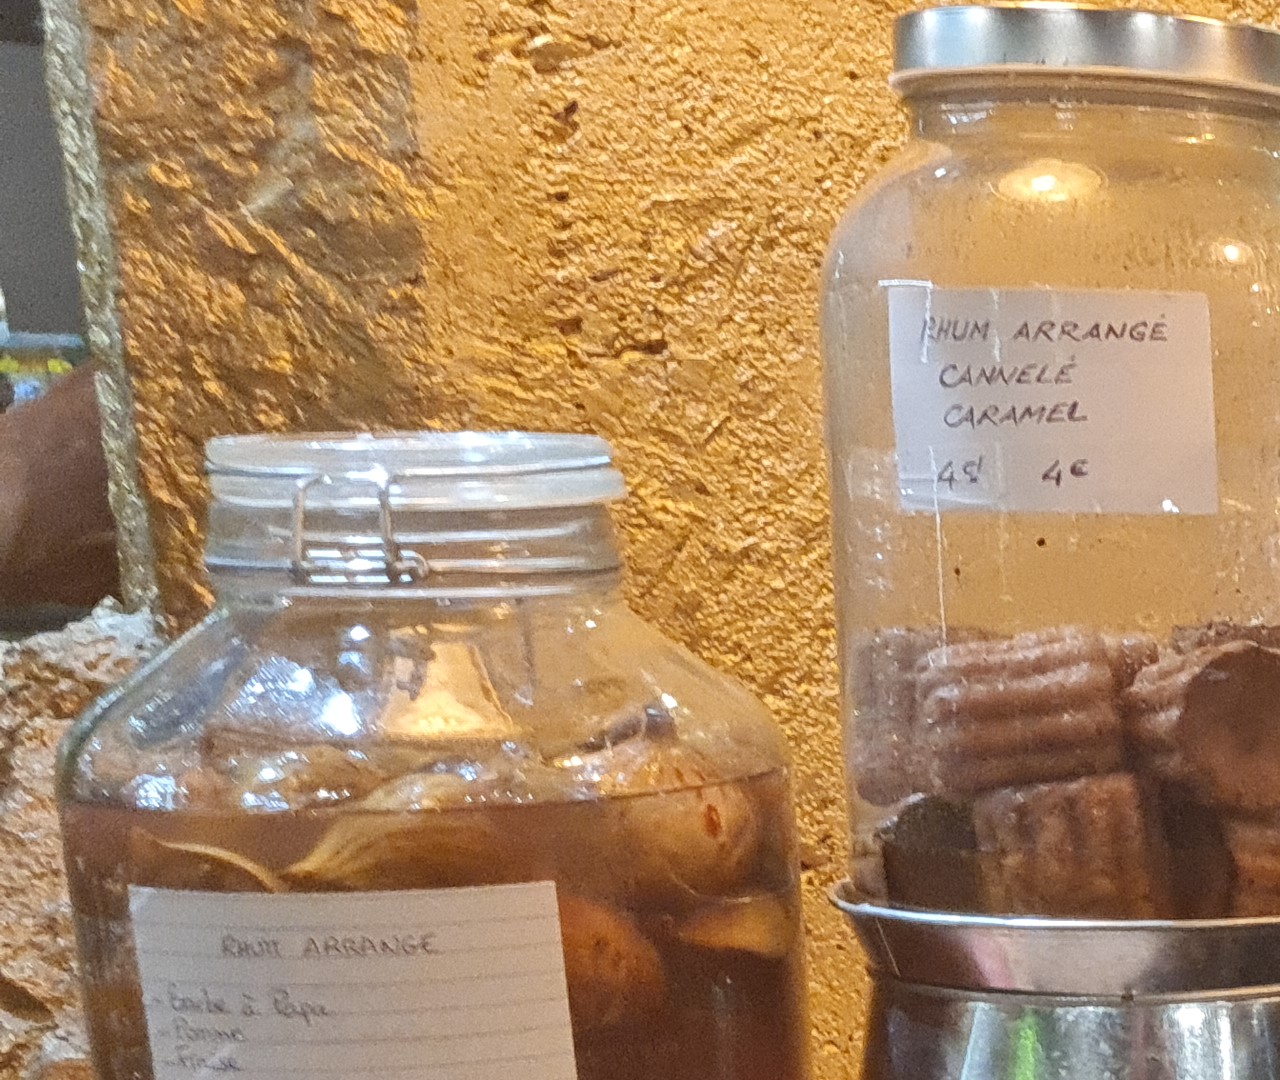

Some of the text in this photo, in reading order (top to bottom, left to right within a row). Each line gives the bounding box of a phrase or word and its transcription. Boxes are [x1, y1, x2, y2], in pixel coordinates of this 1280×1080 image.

[921, 313, 1169, 342] RHUM ARRANGÉ
[943, 401, 1088, 429] CARAMEL
